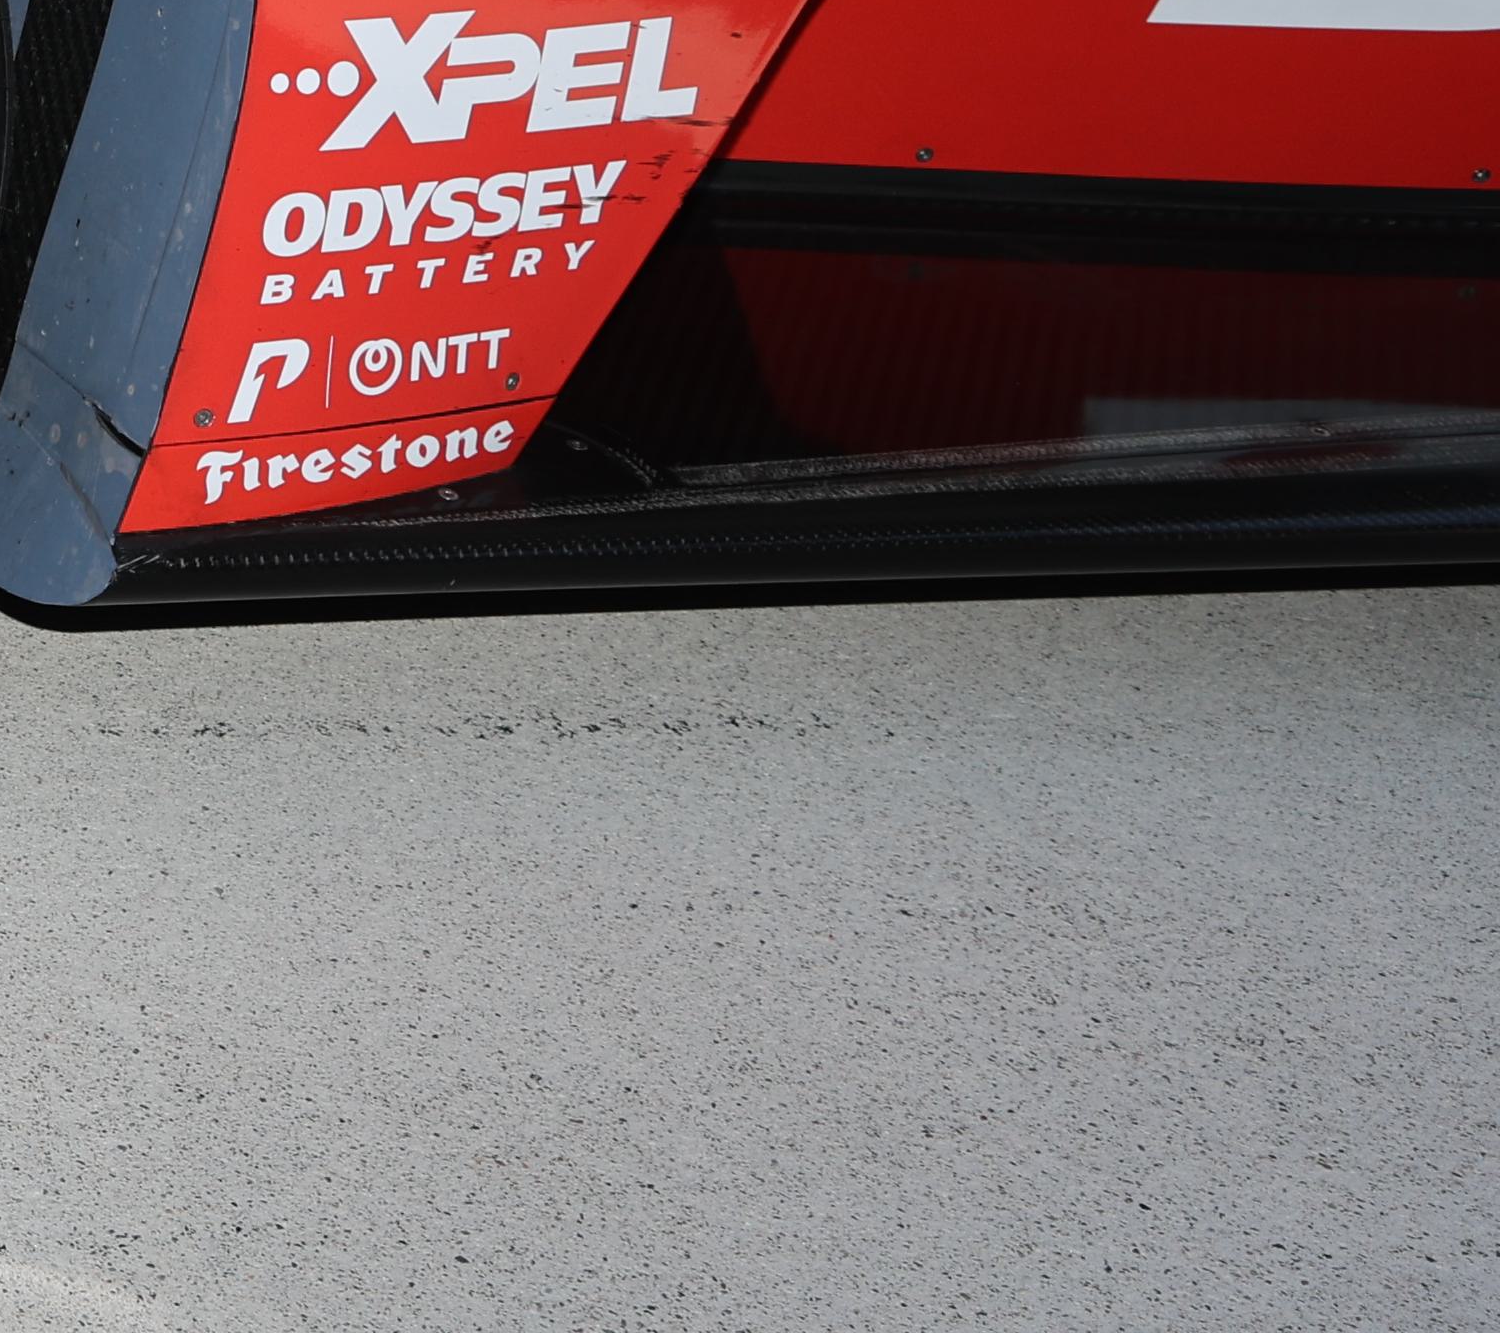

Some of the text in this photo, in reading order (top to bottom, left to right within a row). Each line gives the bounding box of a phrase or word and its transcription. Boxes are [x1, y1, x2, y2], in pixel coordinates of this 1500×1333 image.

[260, 159, 628, 259] ODYSSEY
[259, 238, 596, 306] BATTERY
[409, 328, 511, 384] NTT
[195, 418, 514, 507] Firestone
